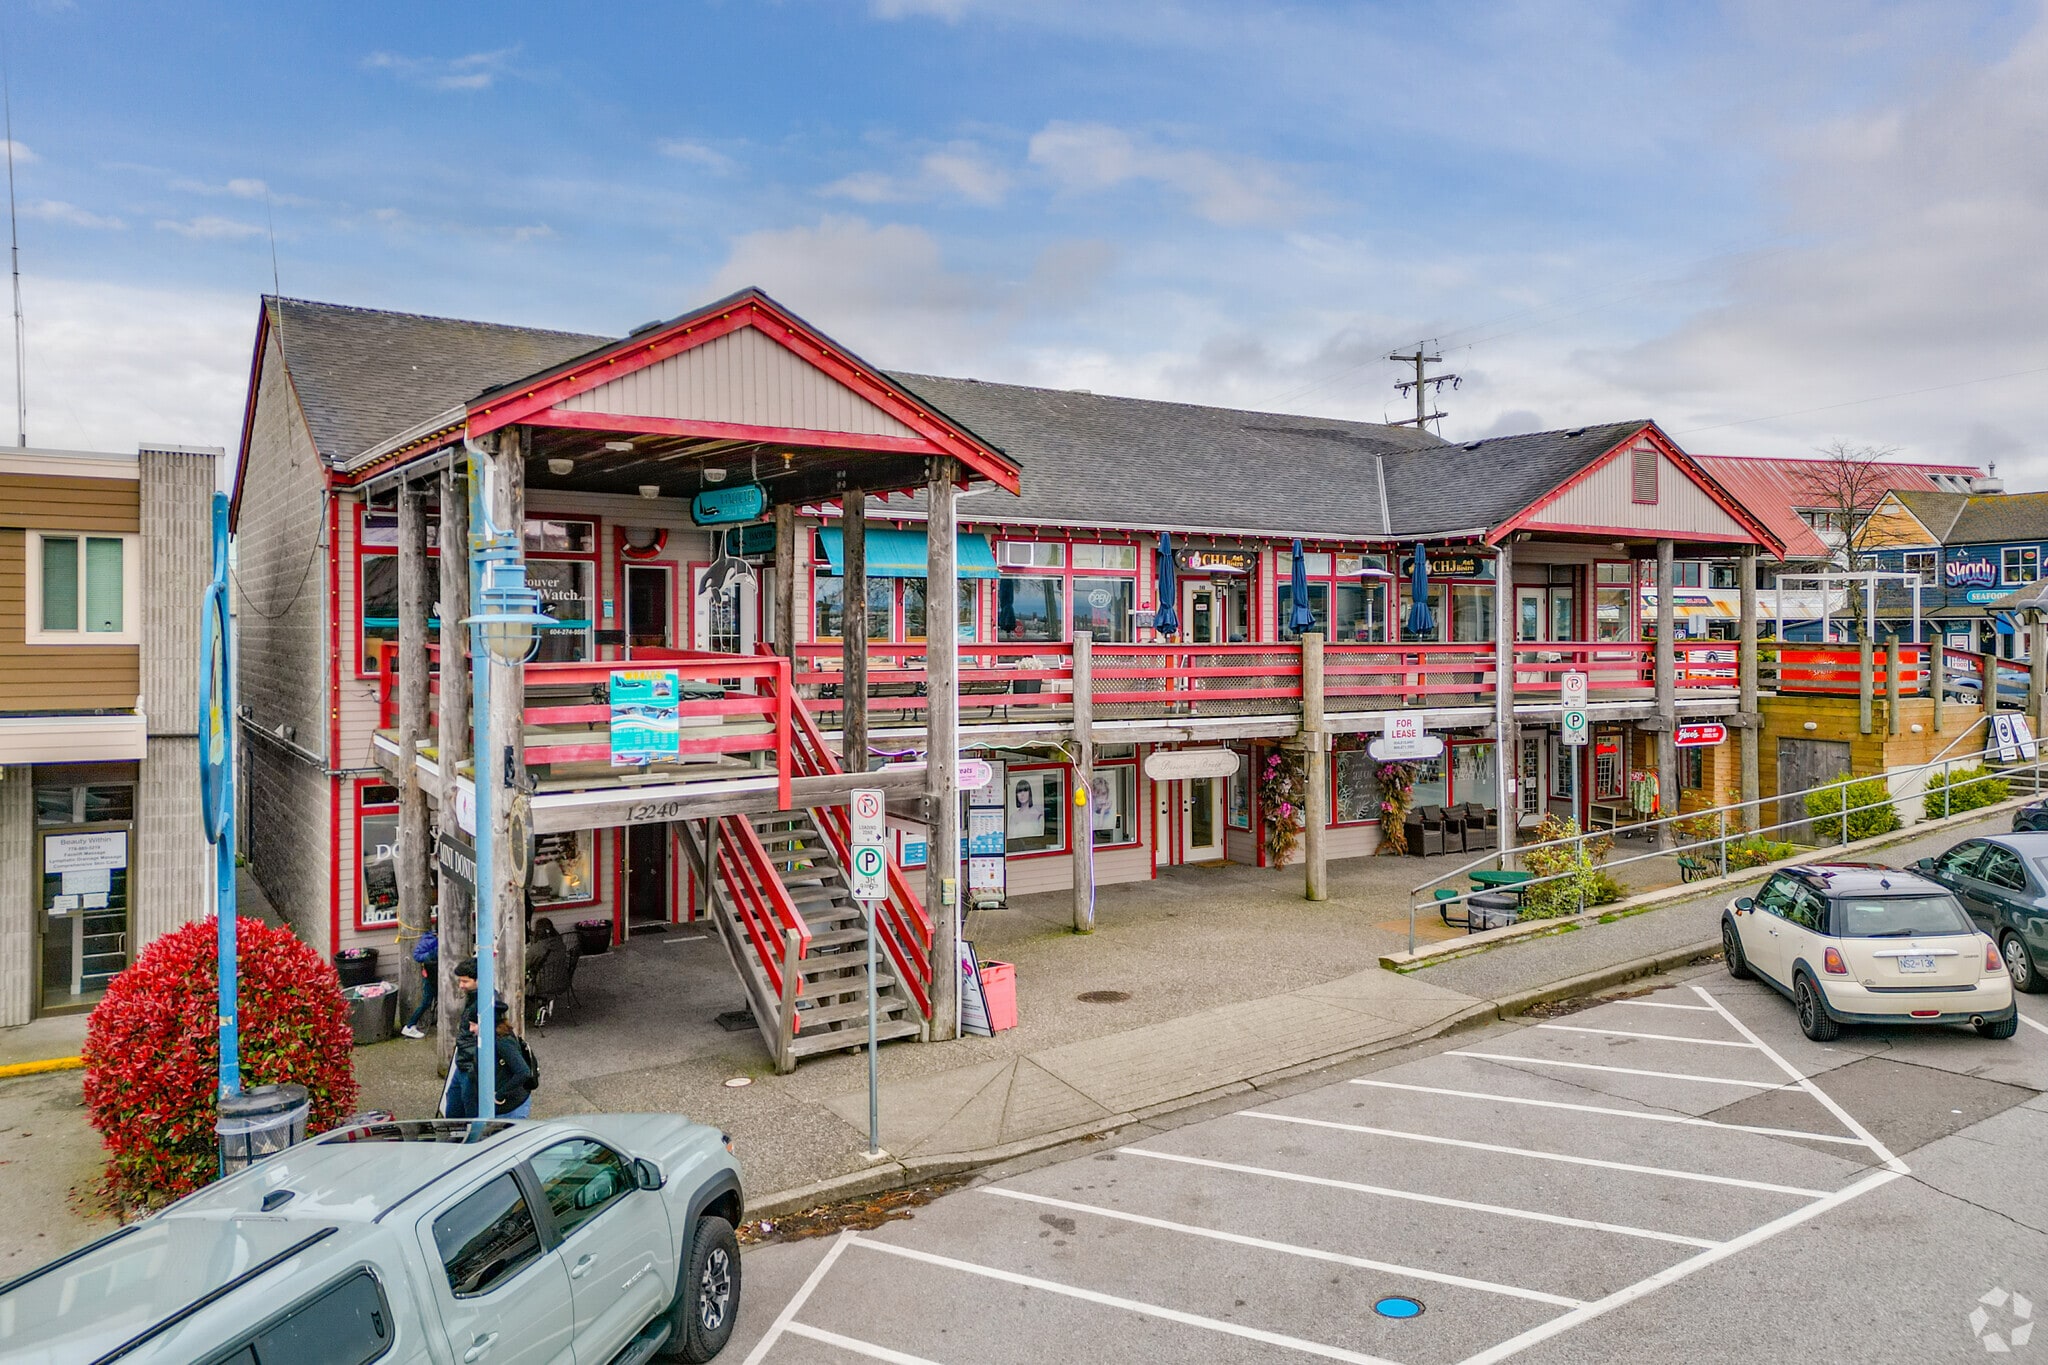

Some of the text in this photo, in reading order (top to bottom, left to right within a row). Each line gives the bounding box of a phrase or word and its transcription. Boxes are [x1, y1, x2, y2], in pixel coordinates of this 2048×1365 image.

[1432, 560, 1457, 572] CHJ
[1945, 557, 1996, 588] Shady
[1396, 719, 1412, 727] FOR
[1391, 729, 1417, 738] LEASE
[625, 801, 679, 821] 12240
[60, 838, 87, 846] Beauty
